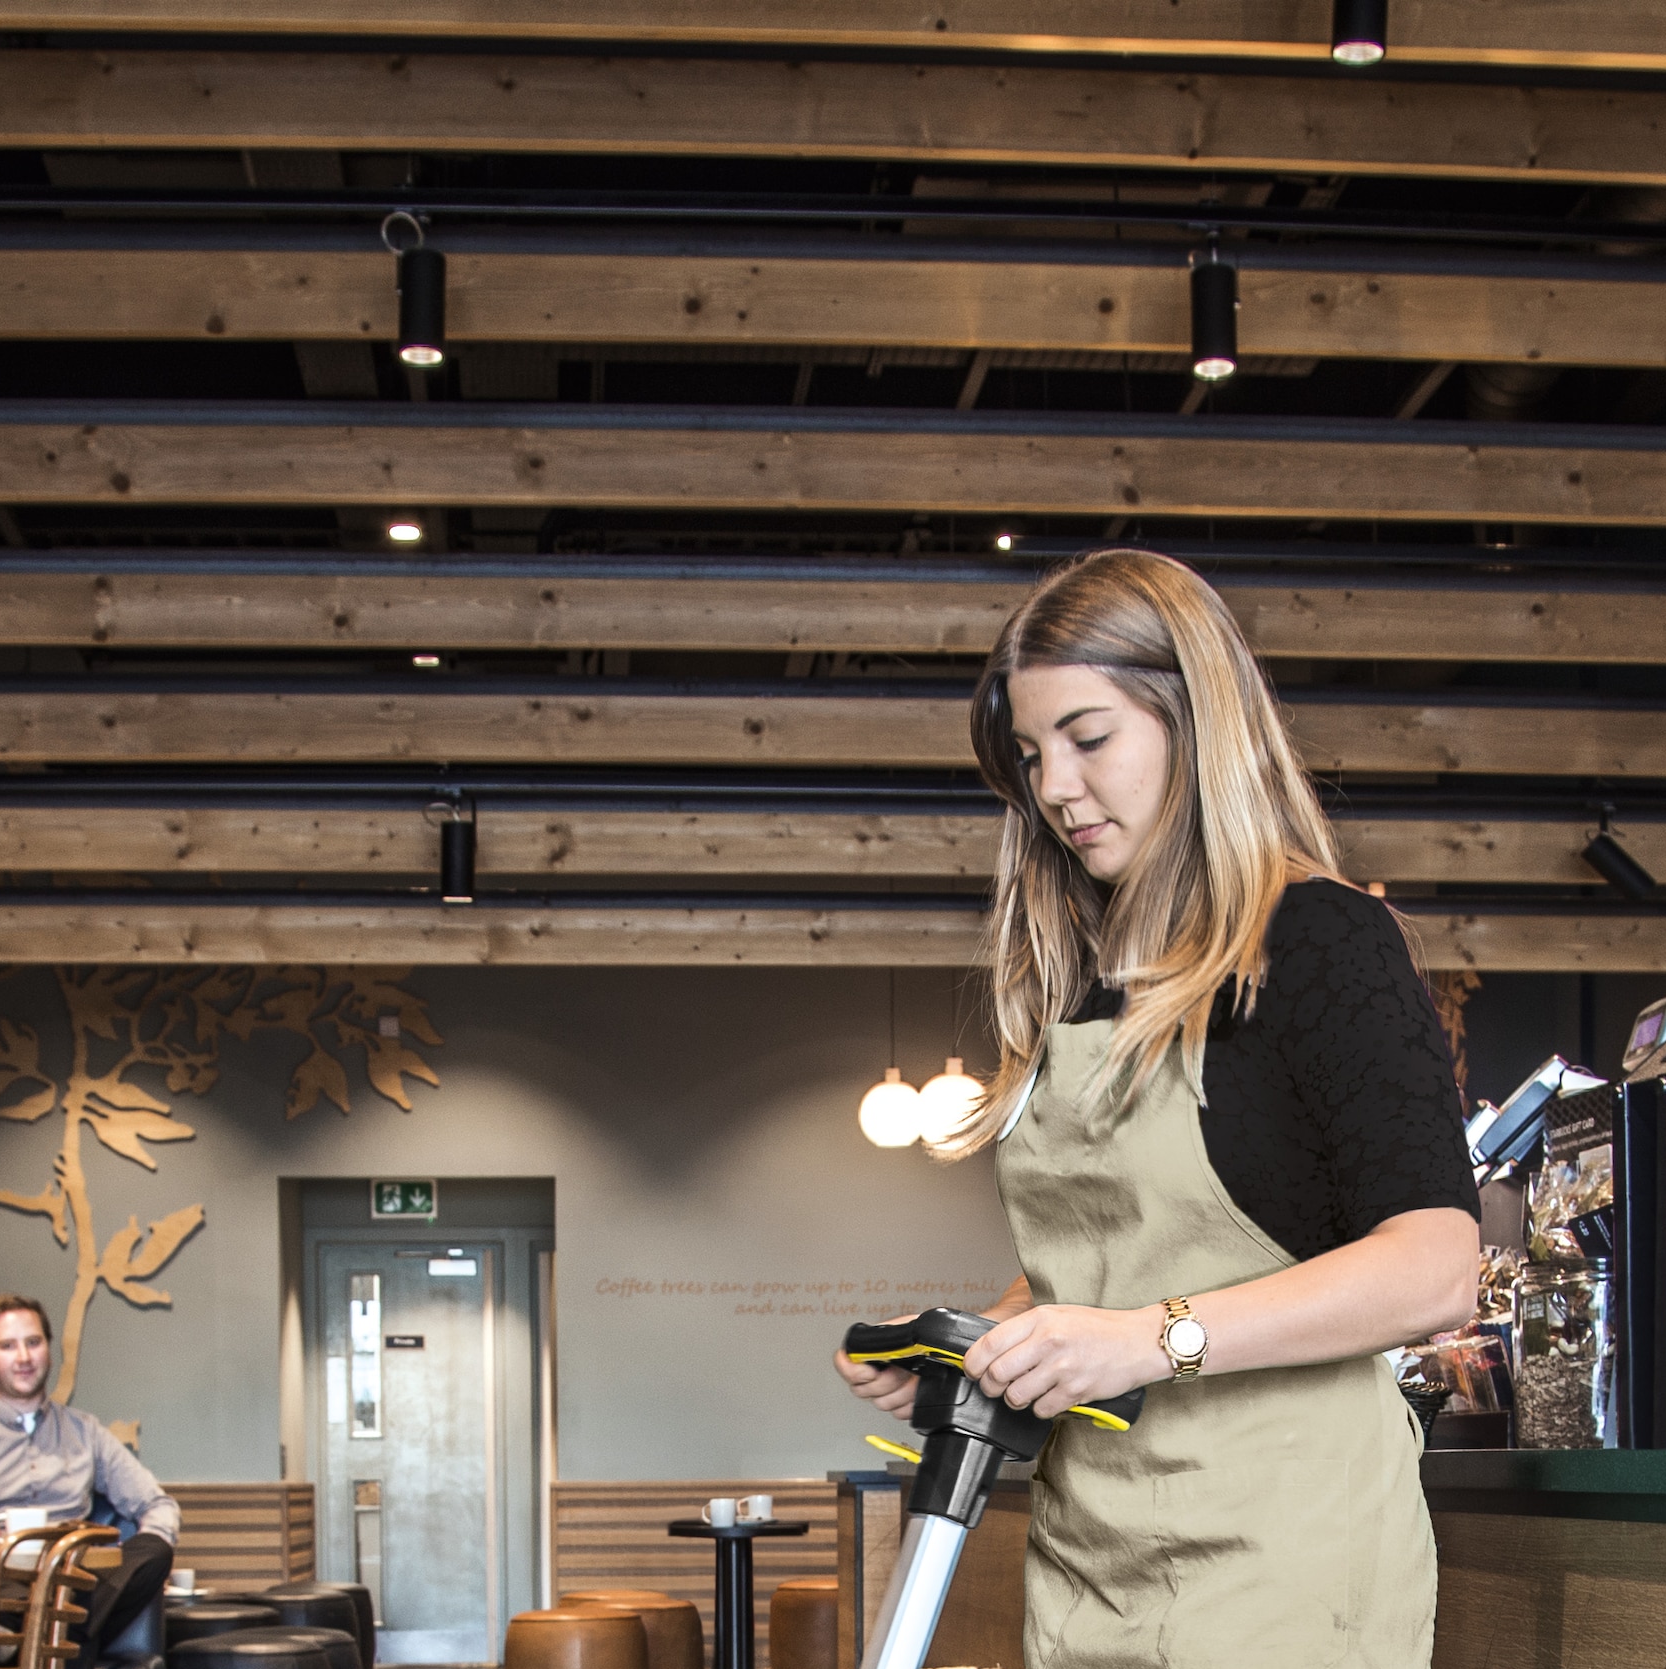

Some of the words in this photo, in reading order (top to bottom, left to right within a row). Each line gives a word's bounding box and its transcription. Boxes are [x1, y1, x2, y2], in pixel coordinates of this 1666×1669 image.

[595, 1277, 654, 1298] Coffee
[660, 1279, 704, 1295] trees
[709, 1281, 747, 1294] can
[752, 1281, 800, 1298] grow
[805, 1281, 831, 1296] up
[838, 1279, 855, 1293] to
[864, 1279, 889, 1293] 10
[896, 1280, 957, 1293] metres
[963, 1277, 997, 1293] tall
[734, 1299, 774, 1315] and
[780, 1303, 814, 1315] can
[824, 1299, 859, 1315] live
